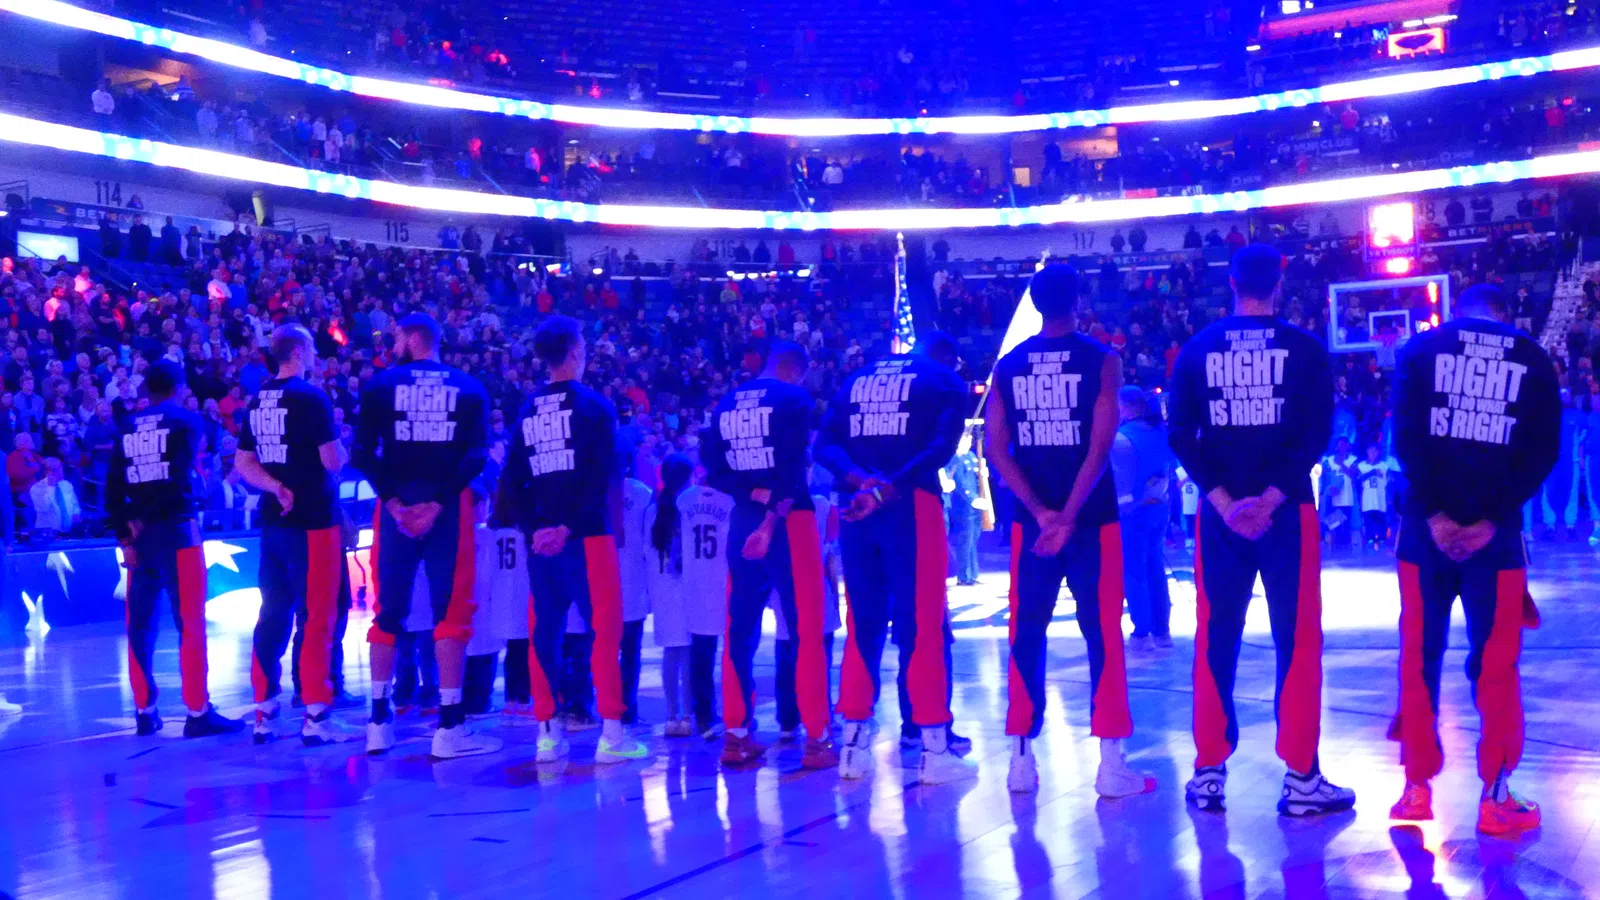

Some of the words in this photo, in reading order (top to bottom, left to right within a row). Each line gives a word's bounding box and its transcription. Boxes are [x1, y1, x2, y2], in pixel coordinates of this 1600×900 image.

[95, 180, 122, 206] 114
[384, 220, 409, 242] 115
[1071, 229, 1095, 249] 117
[1206, 349, 1289, 388] RIGHT
[1434, 353, 1528, 403] RIGHT
[394, 384, 460, 412] RIGHT
[850, 373, 917, 403] RIGHT
[1012, 374, 1082, 410] RIGHT
[1222, 387, 1234, 400] TO
[1234, 386, 1248, 399] DO
[1248, 385, 1274, 399] WHAT
[1209, 399, 1228, 426] IS
[1230, 398, 1285, 426] RIGHT
[1448, 393, 1460, 408] TO
[1460, 395, 1476, 411] DO
[1476, 398, 1508, 415] WHAT
[249, 408, 288, 436] RIGHT
[394, 420, 411, 441] IS
[412, 421, 457, 441] RIGHT
[522, 409, 573, 447] RIGHT
[719, 406, 773, 440] RIGHT
[849, 413, 862, 437] IS
[863, 412, 910, 436] RIGHT
[1017, 421, 1032, 446] IS
[1033, 421, 1081, 446] RIGHT
[1430, 406, 1450, 437] IS
[1450, 409, 1517, 445] RIGHT
[123, 428, 170, 458] RIGHT
[539, 449, 575, 474] RIGHT
[735, 446, 775, 471] RIGHT
[1185, 484, 1193, 494] 15
[496, 537, 516, 570] 15
[693, 523, 717, 560] 15
